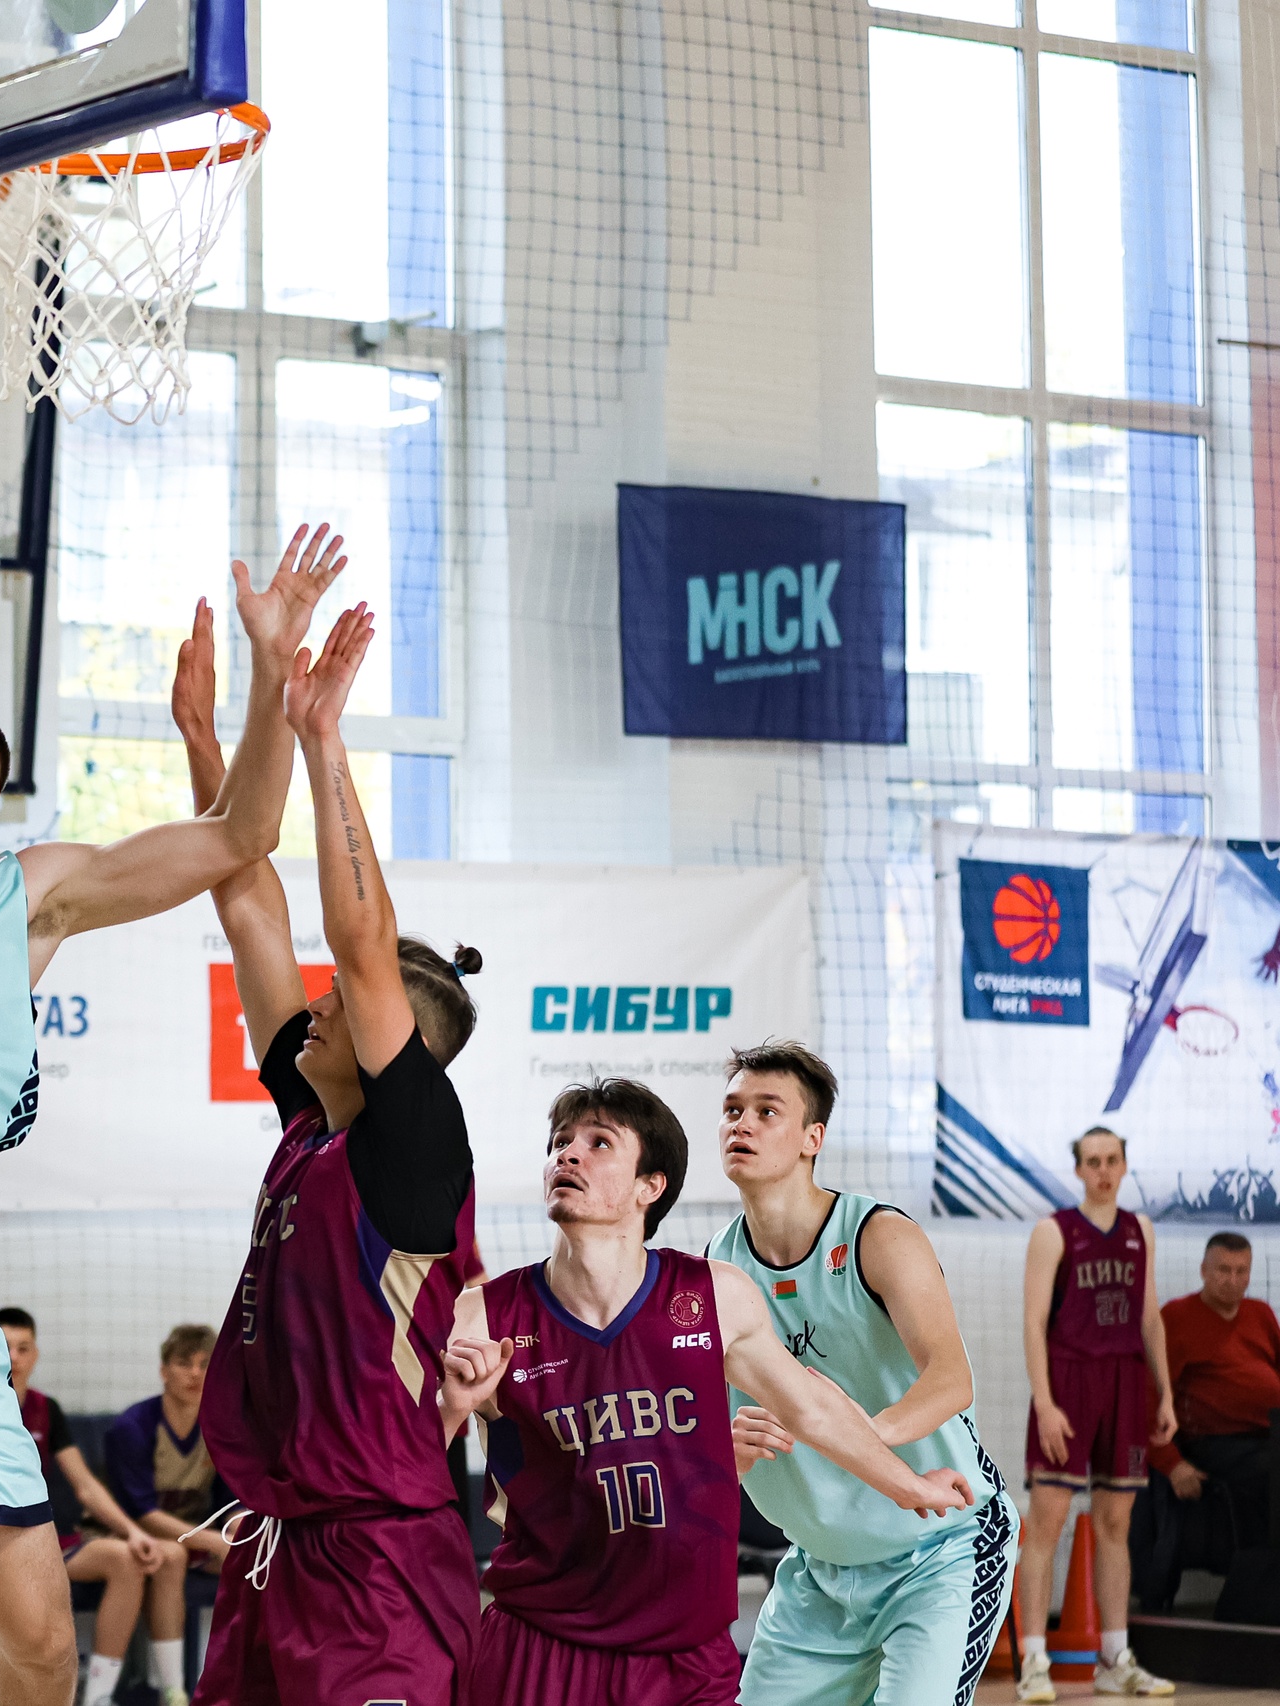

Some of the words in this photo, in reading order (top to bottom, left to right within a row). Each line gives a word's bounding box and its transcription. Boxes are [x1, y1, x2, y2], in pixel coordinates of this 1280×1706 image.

[530, 985, 733, 1032] СИБУР
[542, 1386, 698, 1457] ЦИВС
[595, 1461, 667, 1535] 10
